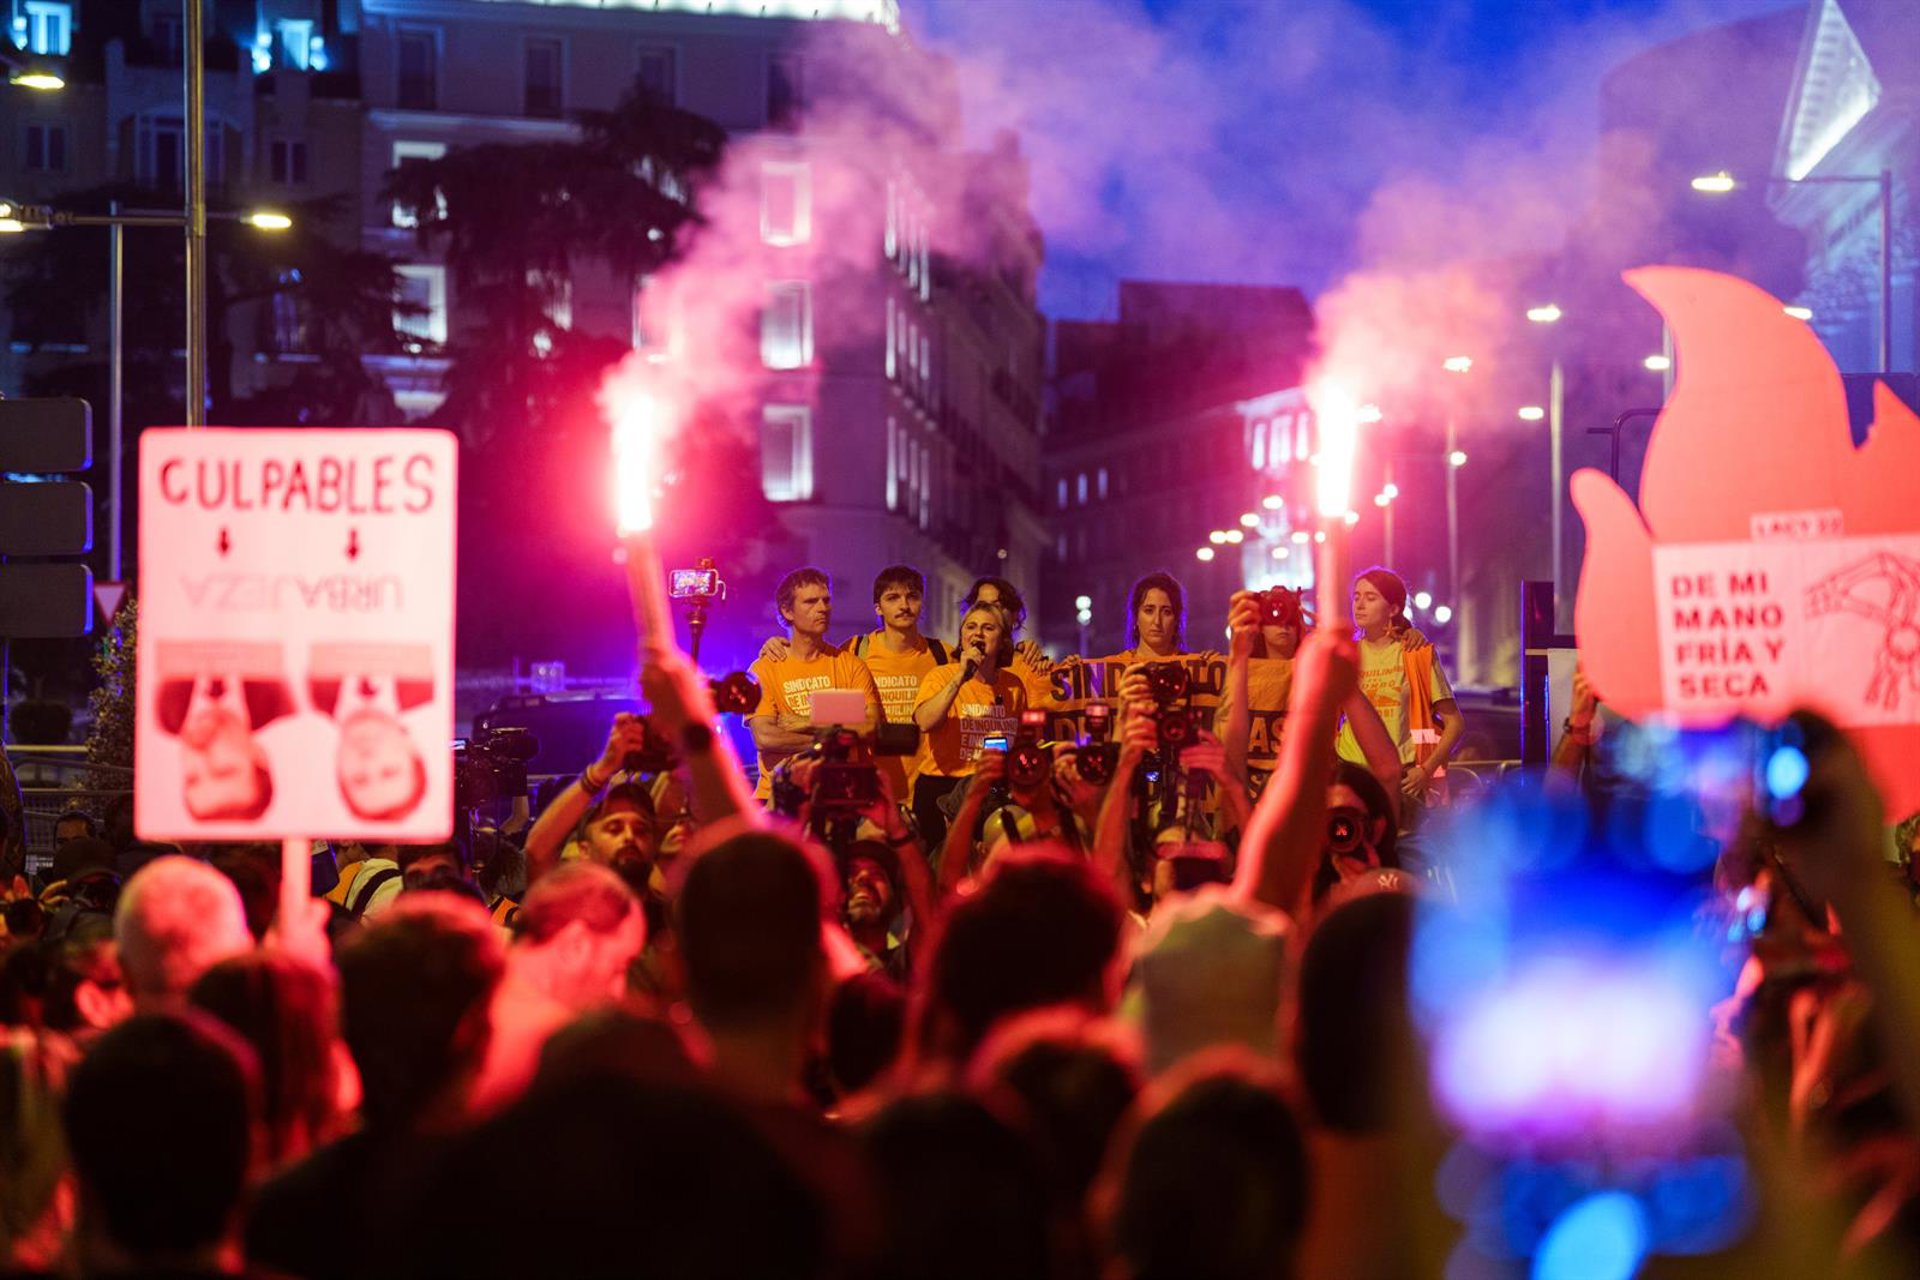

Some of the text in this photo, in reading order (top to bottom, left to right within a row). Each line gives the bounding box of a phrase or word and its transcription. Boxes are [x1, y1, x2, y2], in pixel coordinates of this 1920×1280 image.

[159, 454, 434, 514] CULPABLES
[1670, 571, 1769, 598] DE MI
[1672, 605, 1784, 631] MANO
[1675, 637, 1786, 667] FRÍA Y
[1051, 661, 1227, 701] SINDTO
[1678, 673, 1769, 698] SECA
